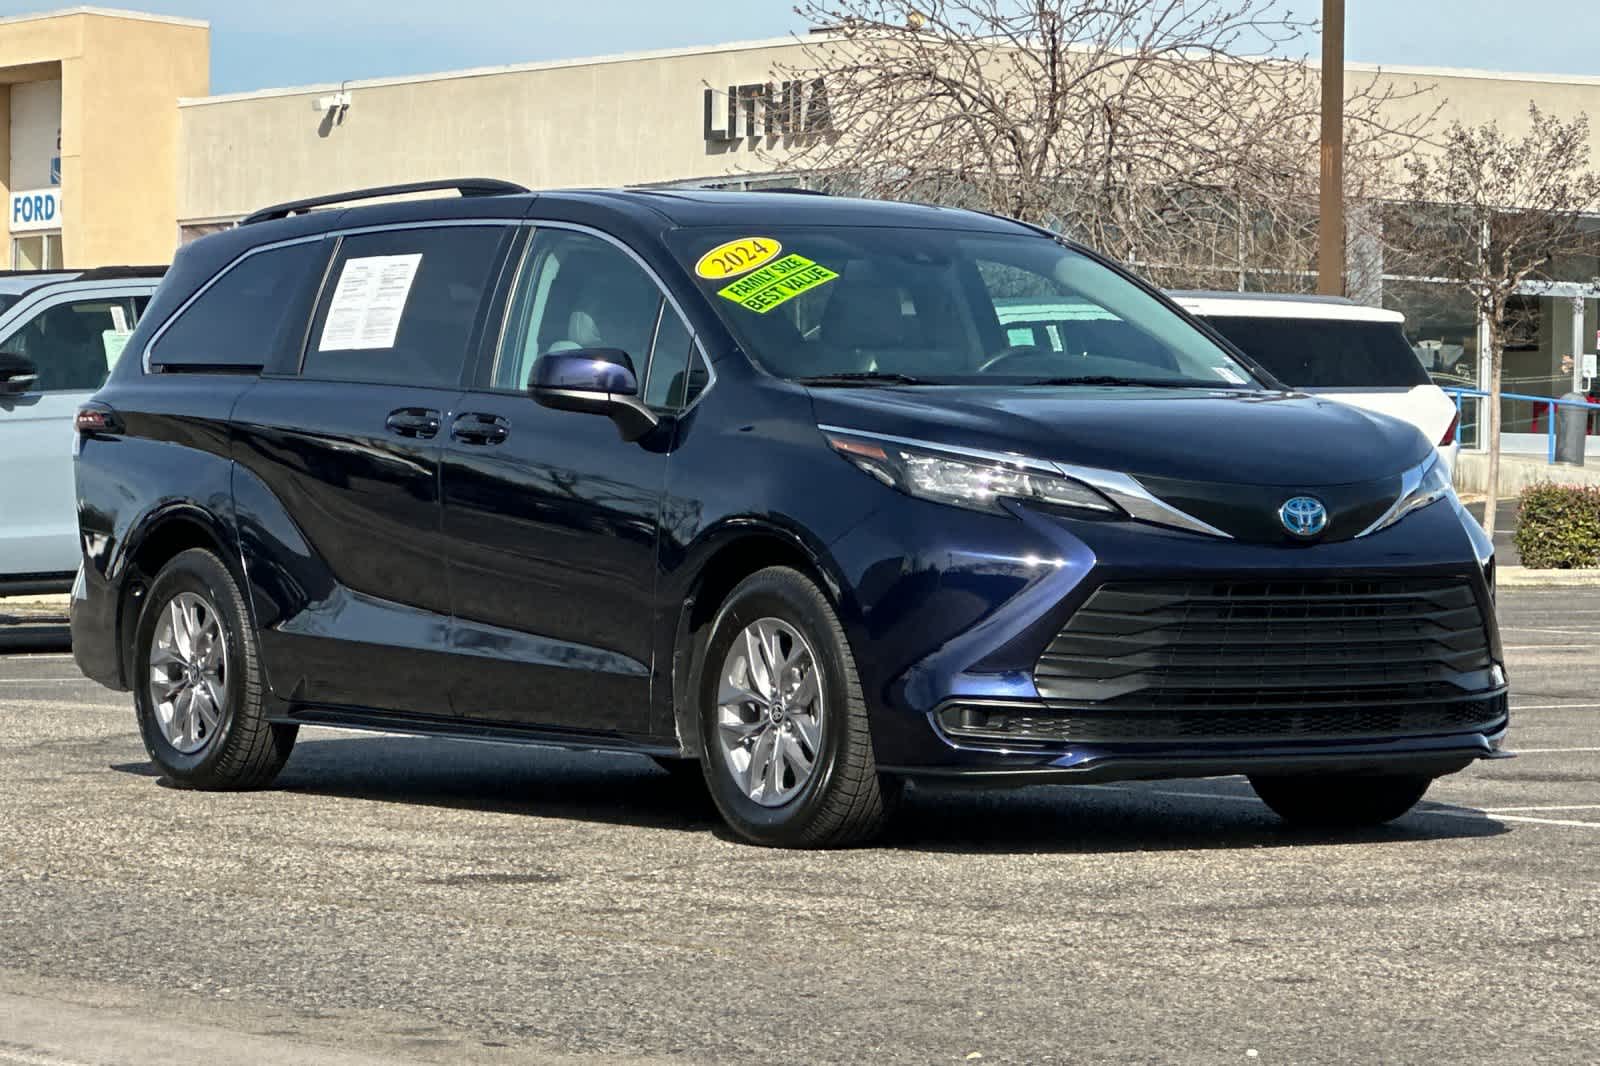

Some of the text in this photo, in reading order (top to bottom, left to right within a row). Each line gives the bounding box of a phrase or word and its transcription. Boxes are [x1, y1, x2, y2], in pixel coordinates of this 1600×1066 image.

[704, 77, 833, 140] LITHIA
[13, 194, 55, 223] FORD
[711, 240, 769, 274] 2024
[728, 256, 803, 297] FAMILY SIZE
[745, 266, 829, 311] BEST VALUE
